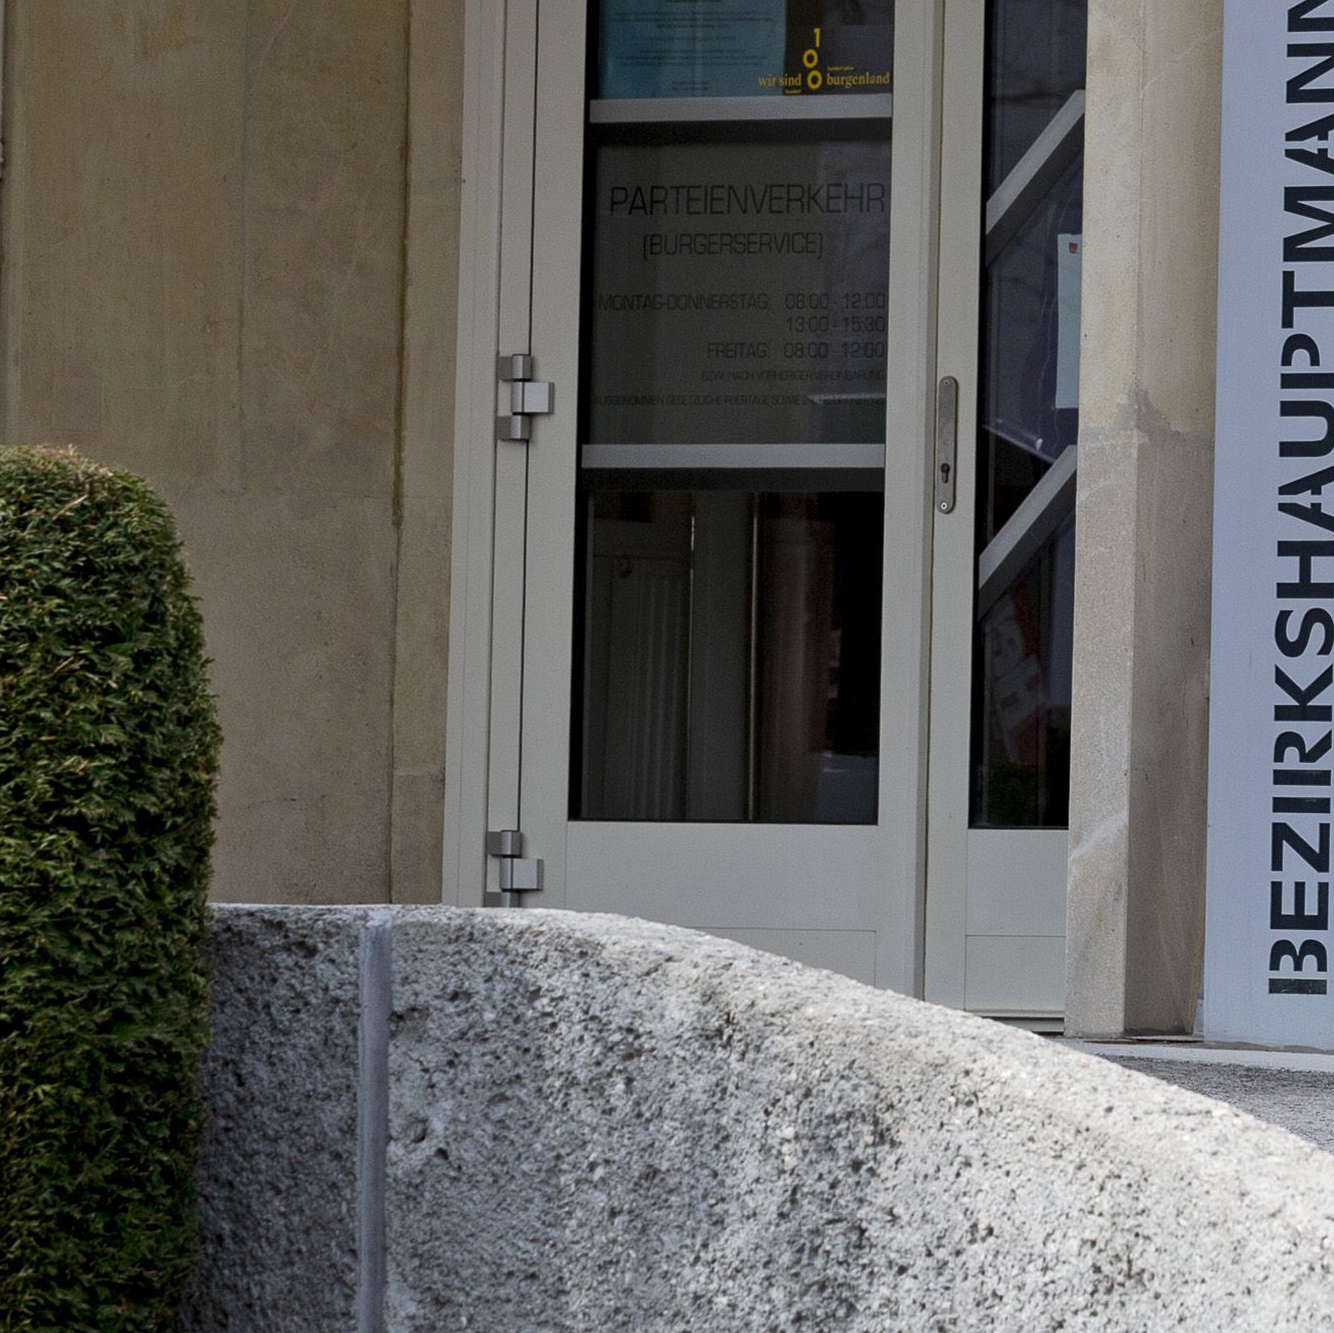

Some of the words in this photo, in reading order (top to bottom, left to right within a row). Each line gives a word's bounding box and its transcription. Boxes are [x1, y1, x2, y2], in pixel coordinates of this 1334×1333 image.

[757, 74, 776, 87] wir
[778, 73, 802, 87] sind
[826, 71, 891, 89] burgenland
[610, 183, 886, 216] PARTEIENVERKEHR
